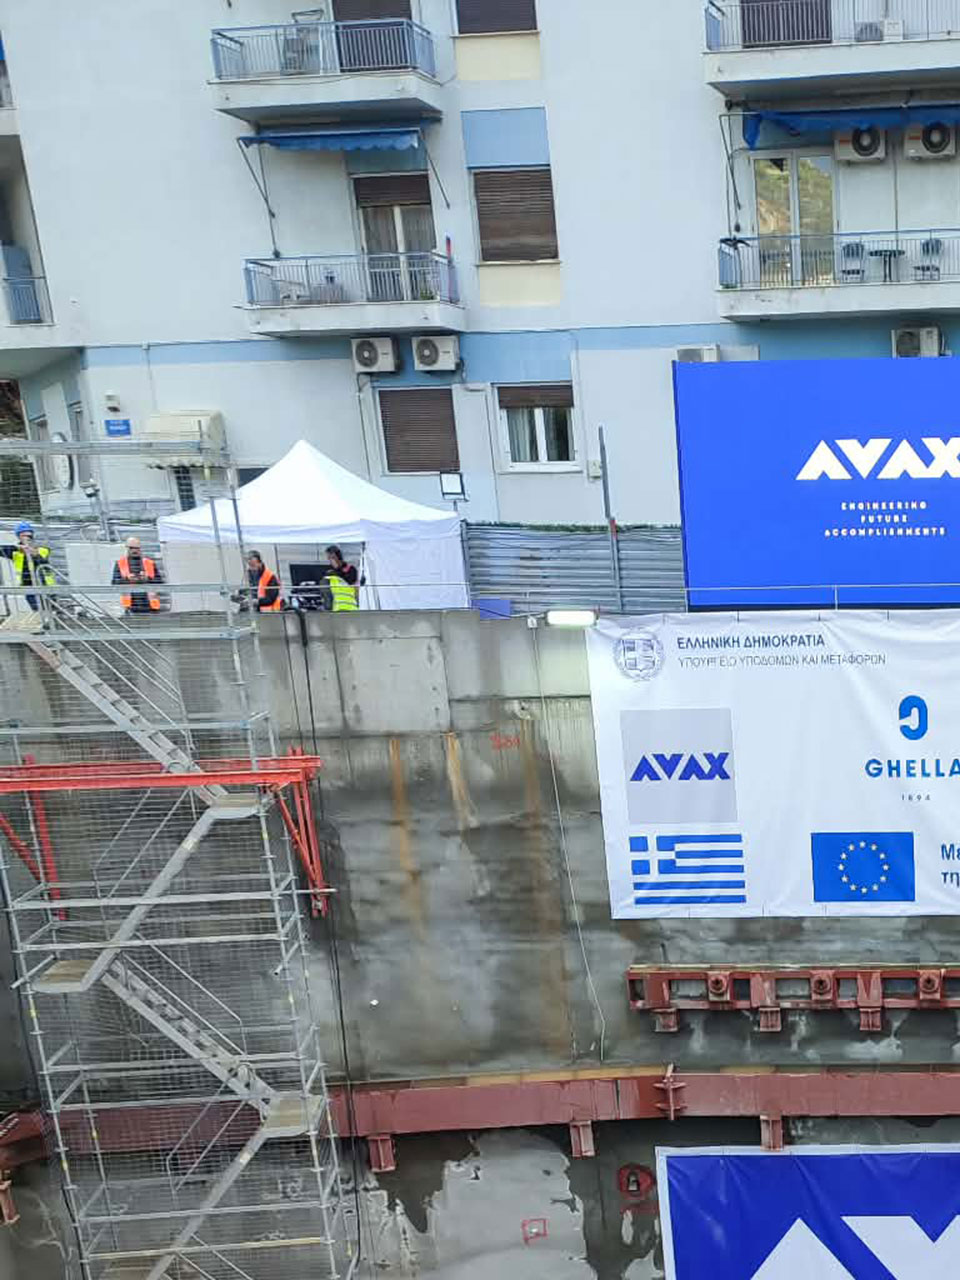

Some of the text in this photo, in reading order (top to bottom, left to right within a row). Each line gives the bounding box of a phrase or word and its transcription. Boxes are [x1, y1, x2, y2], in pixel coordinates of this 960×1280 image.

[677, 634, 826, 650] ΕΛΛΗΝΙΚΗ ΔΗΜΟΚΡΑΤΙΑ
[740, 654, 800, 667] ΥΠΟΔΟΜΩΝ
[801, 654, 819, 666] ΚΑΙ
[820, 653, 887, 666] ΜΕΤΑΦΟΡΩΝ
[629, 751, 731, 782] AVAX
